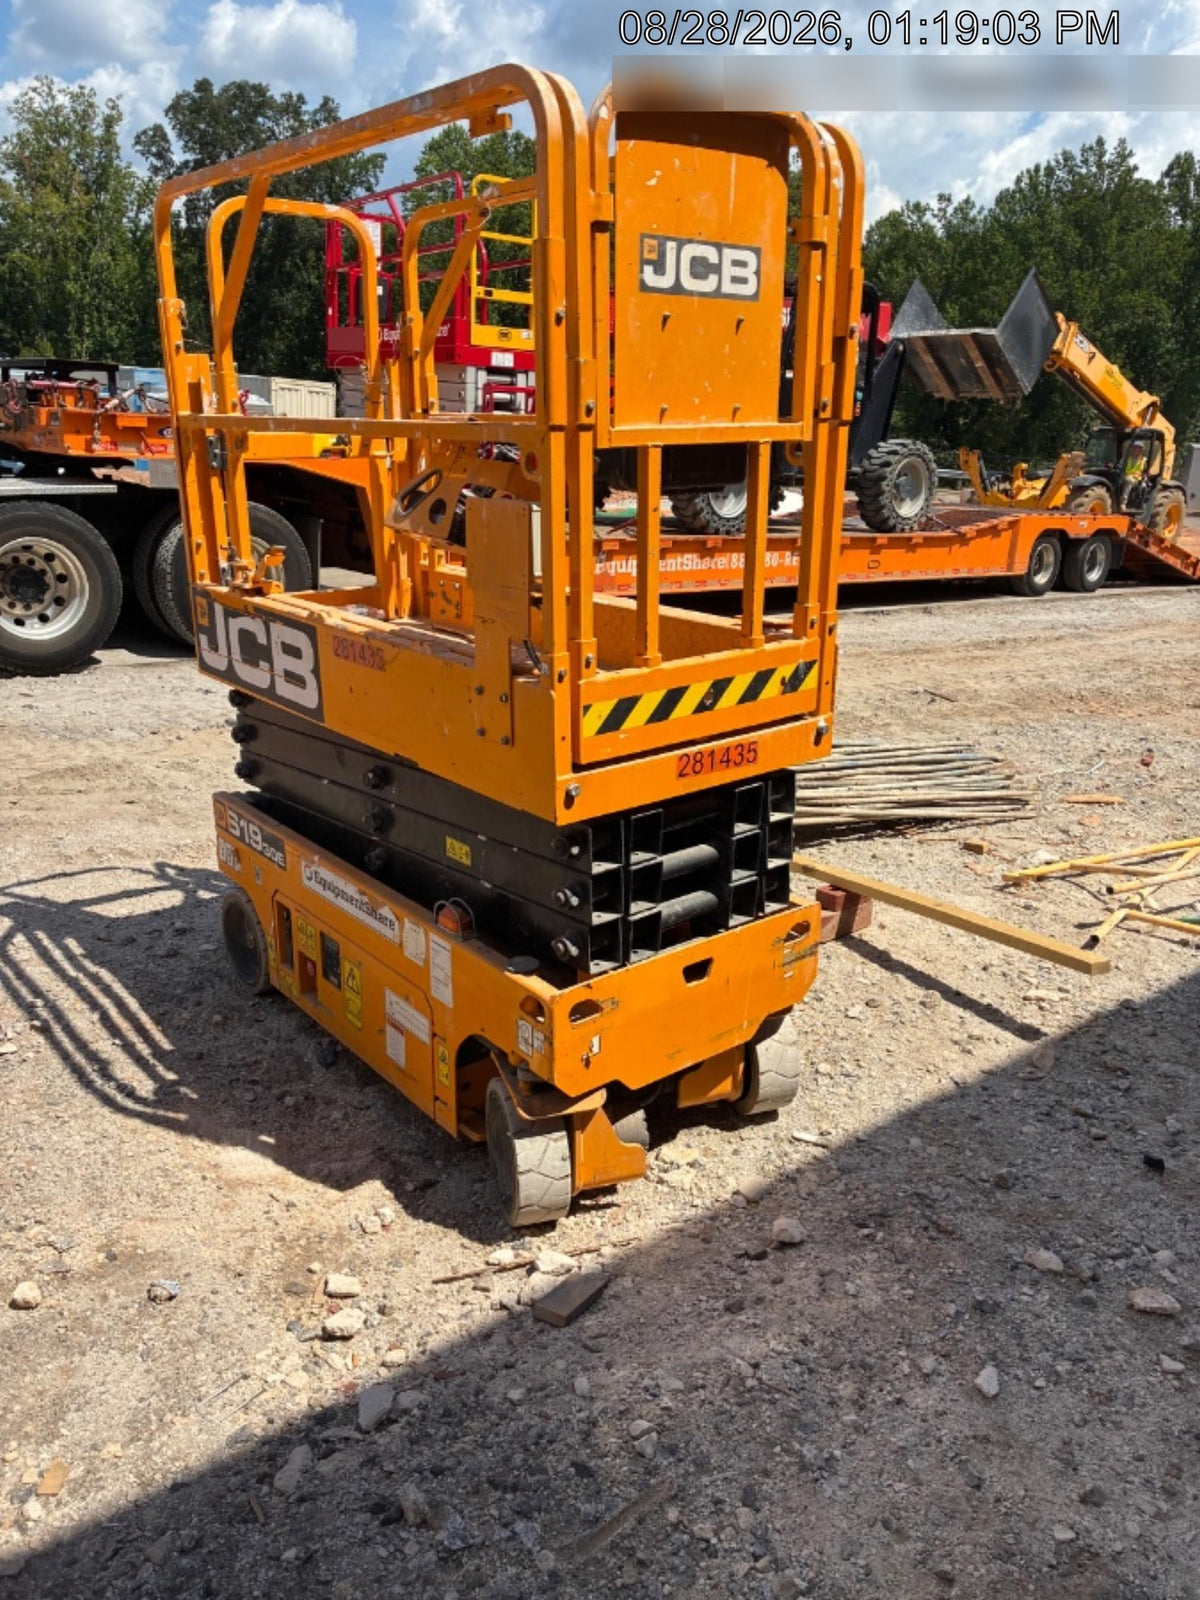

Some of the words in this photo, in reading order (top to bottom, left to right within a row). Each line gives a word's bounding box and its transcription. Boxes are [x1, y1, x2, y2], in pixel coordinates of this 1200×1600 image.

[642, 240, 758, 296] JCB
[198, 601, 319, 710] JCB
[333, 635, 386, 673] 281435
[677, 740, 758, 778] 281435
